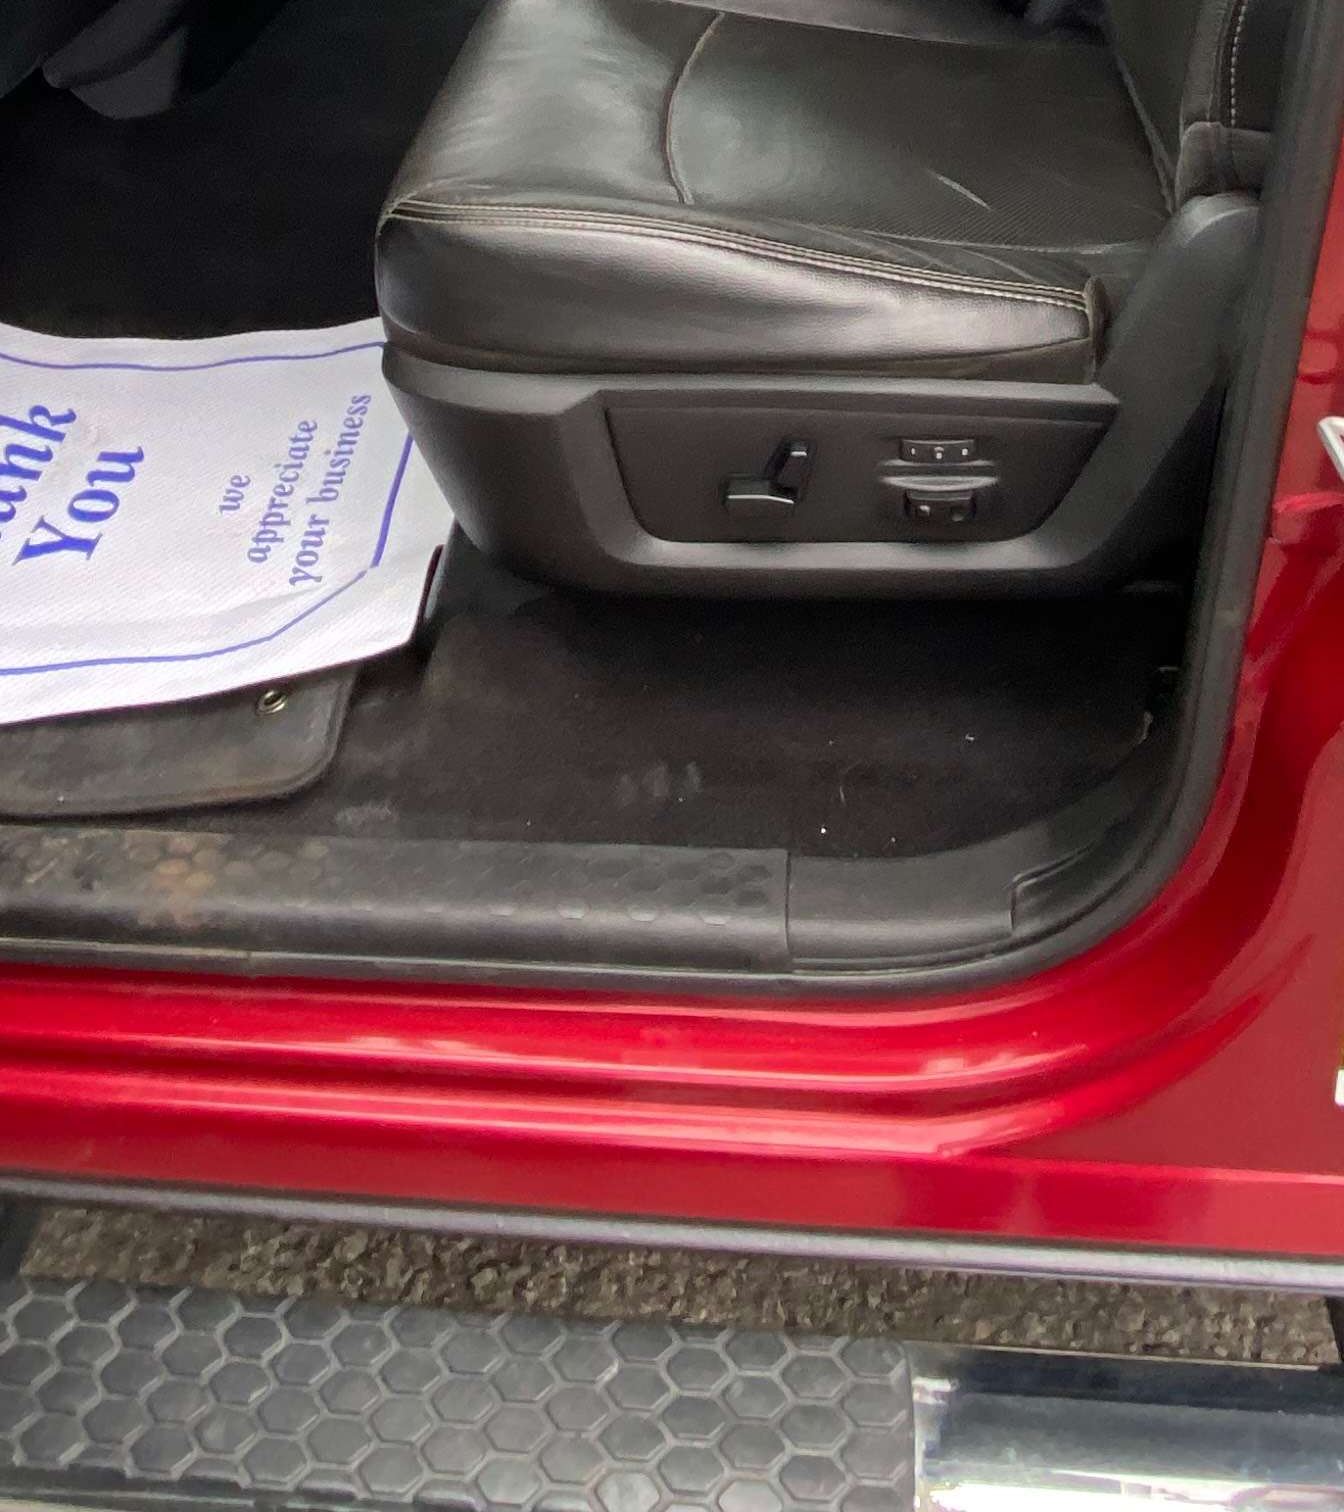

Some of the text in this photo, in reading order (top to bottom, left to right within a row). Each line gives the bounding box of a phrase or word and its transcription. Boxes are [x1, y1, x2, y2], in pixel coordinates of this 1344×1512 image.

[11, 445, 145, 567] You
[218, 474, 252, 515] we
[247, 419, 319, 564] appreciate
[288, 394, 372, 586] your business
